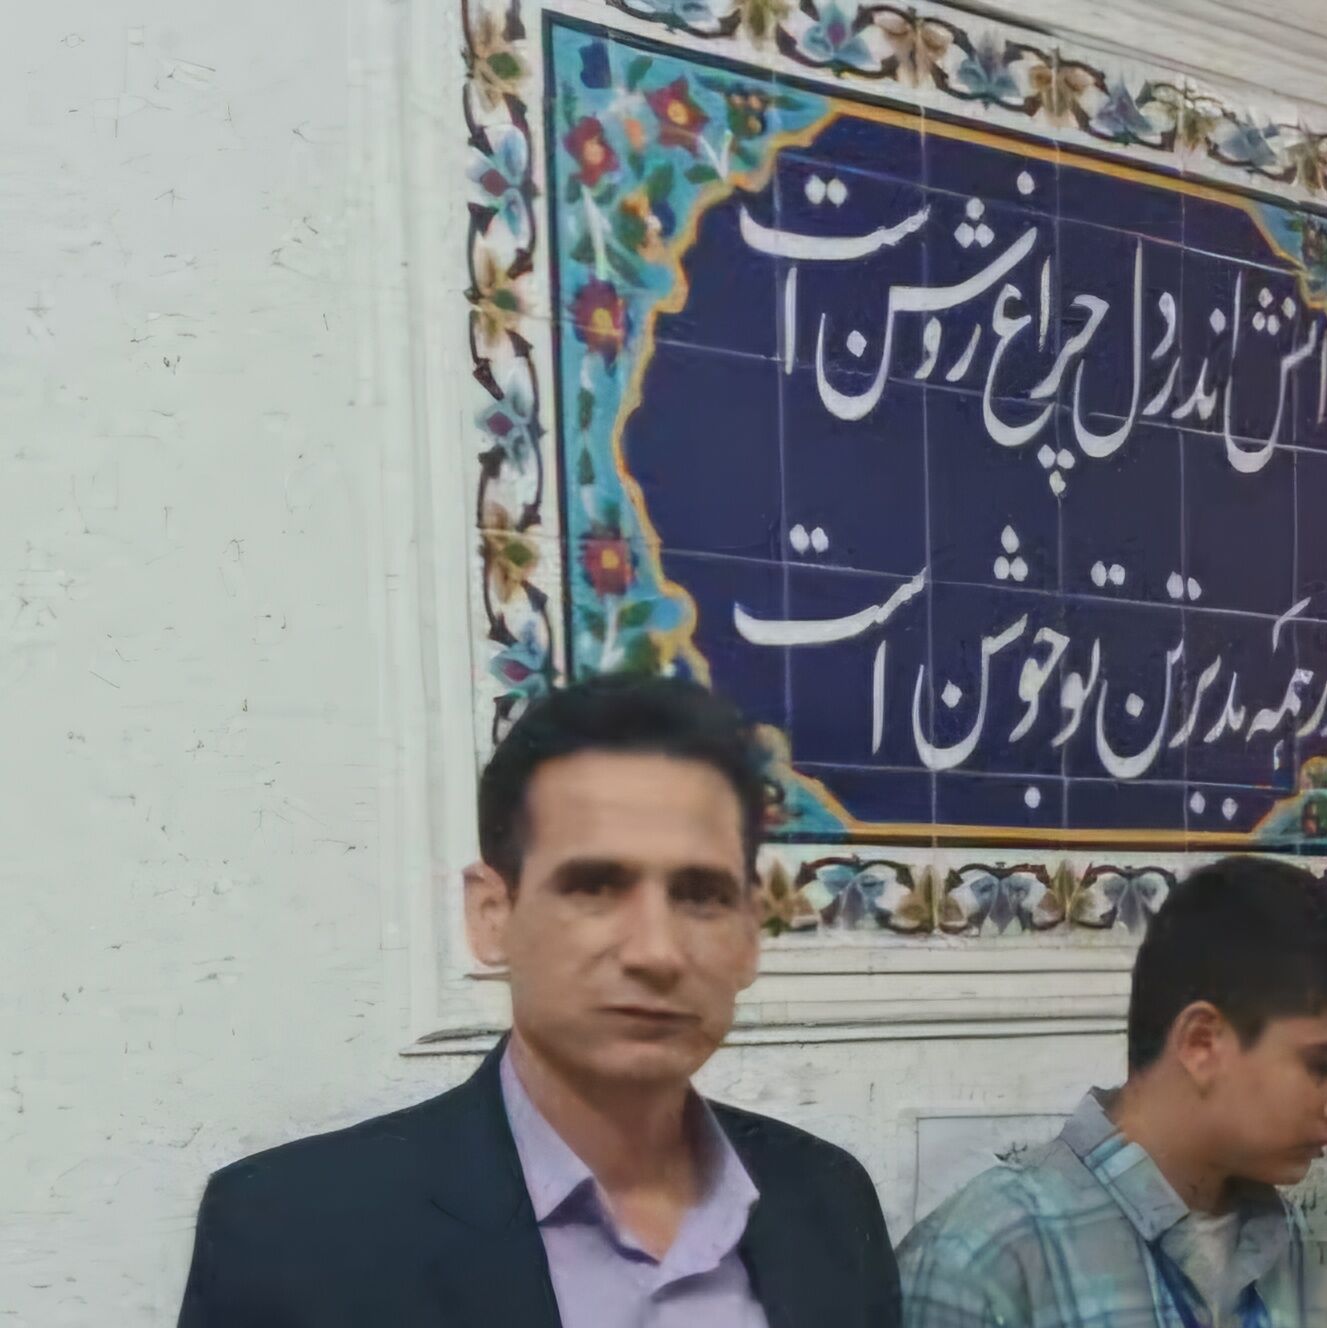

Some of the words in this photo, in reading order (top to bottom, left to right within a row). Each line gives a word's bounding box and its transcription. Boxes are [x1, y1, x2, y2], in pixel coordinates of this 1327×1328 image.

[738, 173, 931, 375] است
[817, 197, 1040, 422] روشن
[983, 169, 1111, 496] چراغ
[1073, 236, 1177, 458] دل
[1142, 270, 1244, 421] اندر
[733, 523, 930, 755] است
[912, 523, 1072, 810] جوشن
[1051, 560, 1127, 748] تو
[1096, 570, 1203, 780] تن
[1167, 653, 1223, 815] بر
[1245, 596, 1315, 772] همه
[1202, 670, 1247, 822] بد
